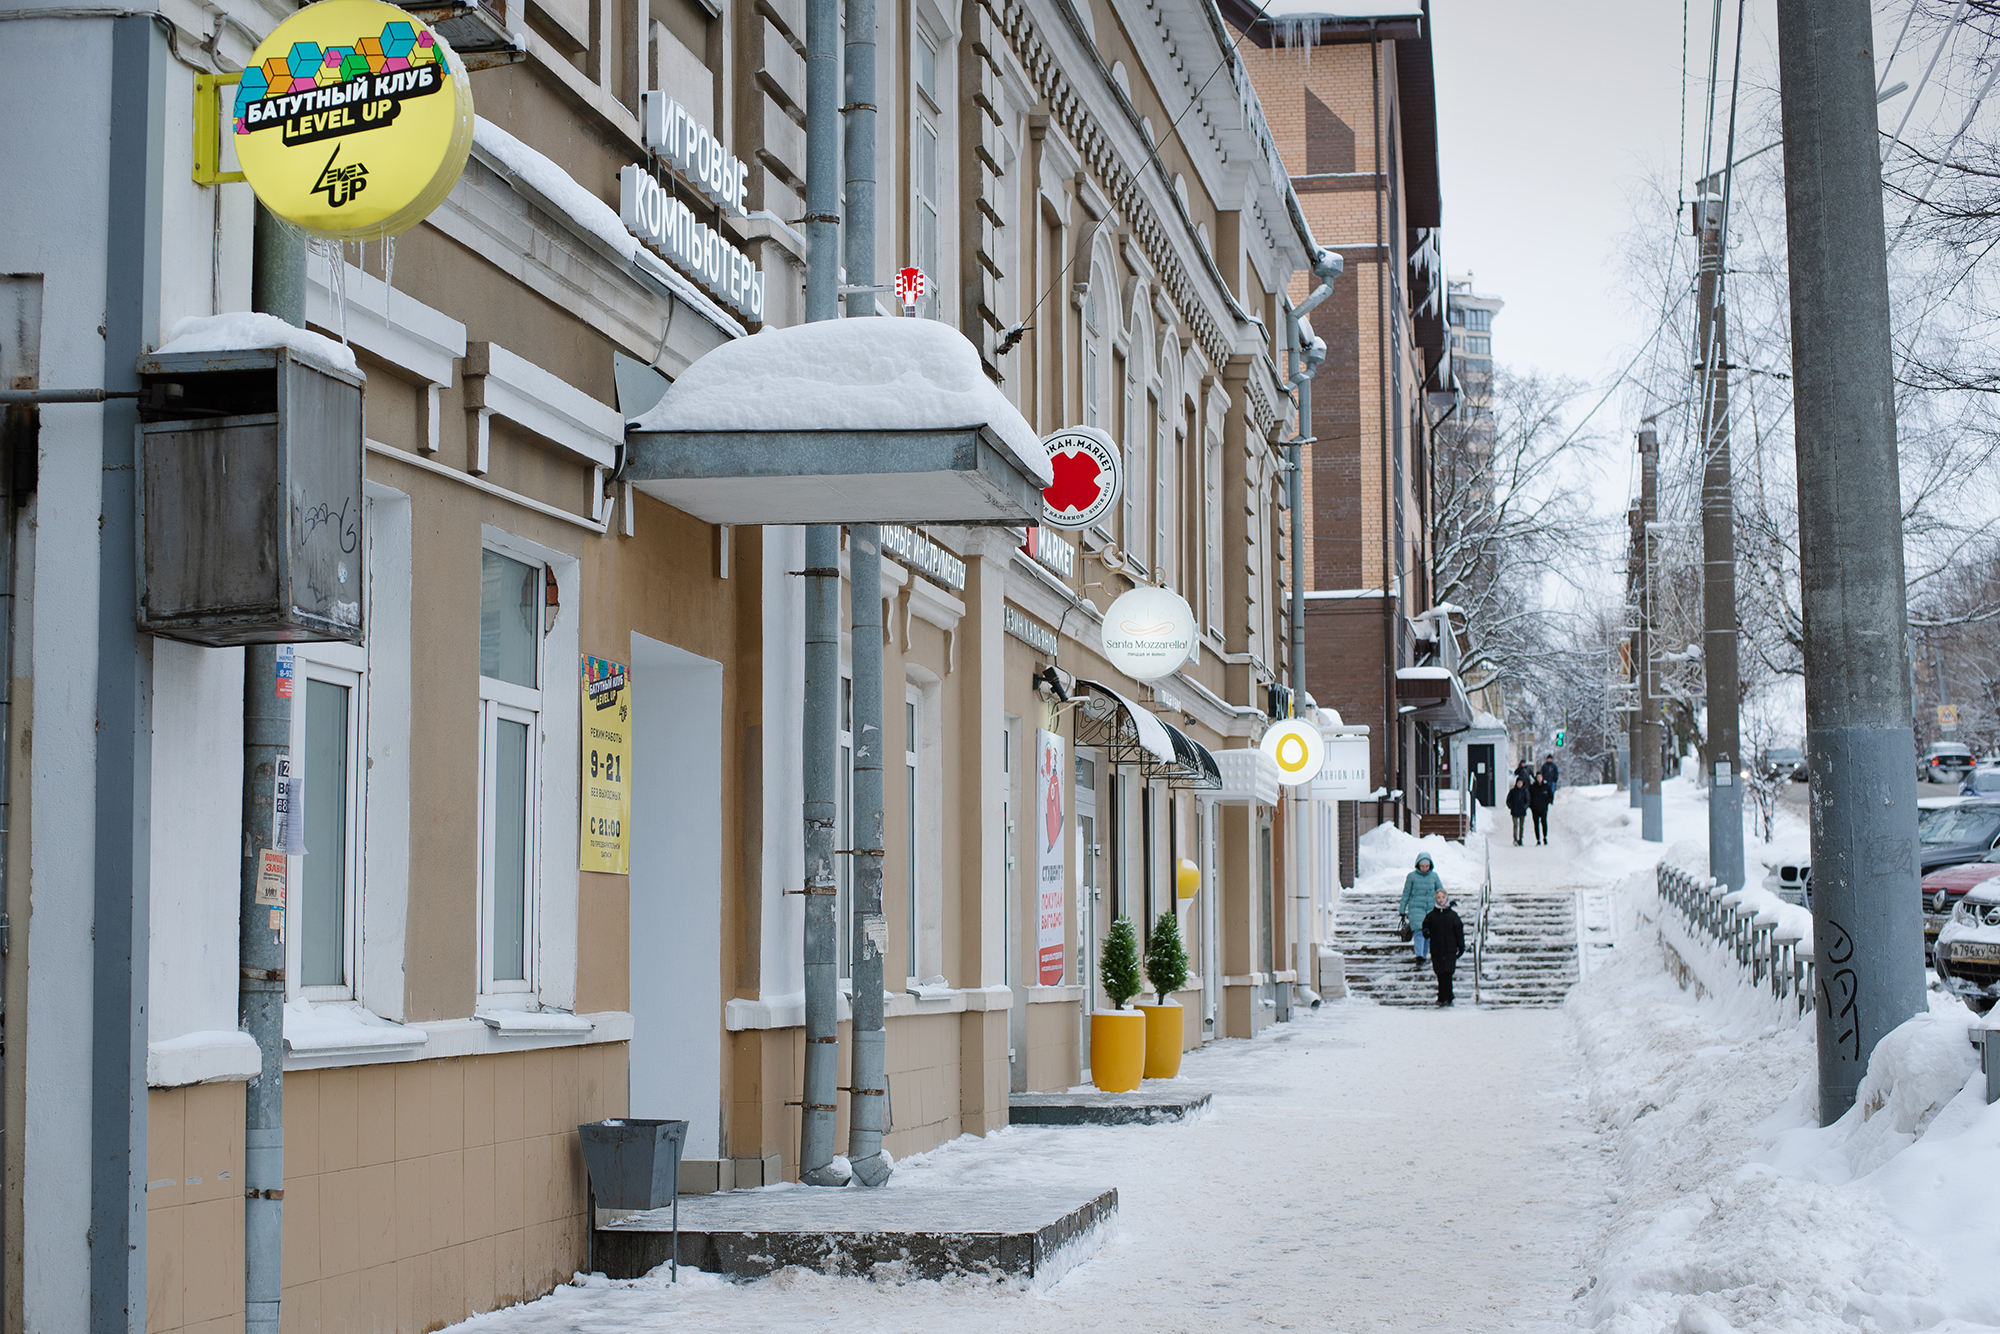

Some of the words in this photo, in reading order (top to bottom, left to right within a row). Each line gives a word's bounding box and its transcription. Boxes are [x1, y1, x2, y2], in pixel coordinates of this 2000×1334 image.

[248, 77, 368, 123] БАТУТНЫЙ
[375, 67, 433, 95] КЛУБ
[286, 110, 355, 138] LEVEL
[362, 99, 392, 121] UP
[661, 89, 748, 217] ИГРОВЫЕ
[328, 177, 367, 208] UP
[635, 162, 765, 322] КОМПЬЮТЕРЫ
[1089, 498, 1104, 514] SINCE
[913, 533, 966, 591] ИНСТРУМЕНТЫ
[1039, 524, 1074, 578] MARKET
[1106, 640, 1133, 649] Santa
[596, 692, 610, 706] LEVEL
[590, 727, 605, 740] РЕЖИМ
[605, 731, 622, 743] РАБОТЫ
[591, 750, 621, 782] 9-21
[598, 818, 620, 838] 21:00
[1041, 886, 1063, 911] ПОКУПАЙ
